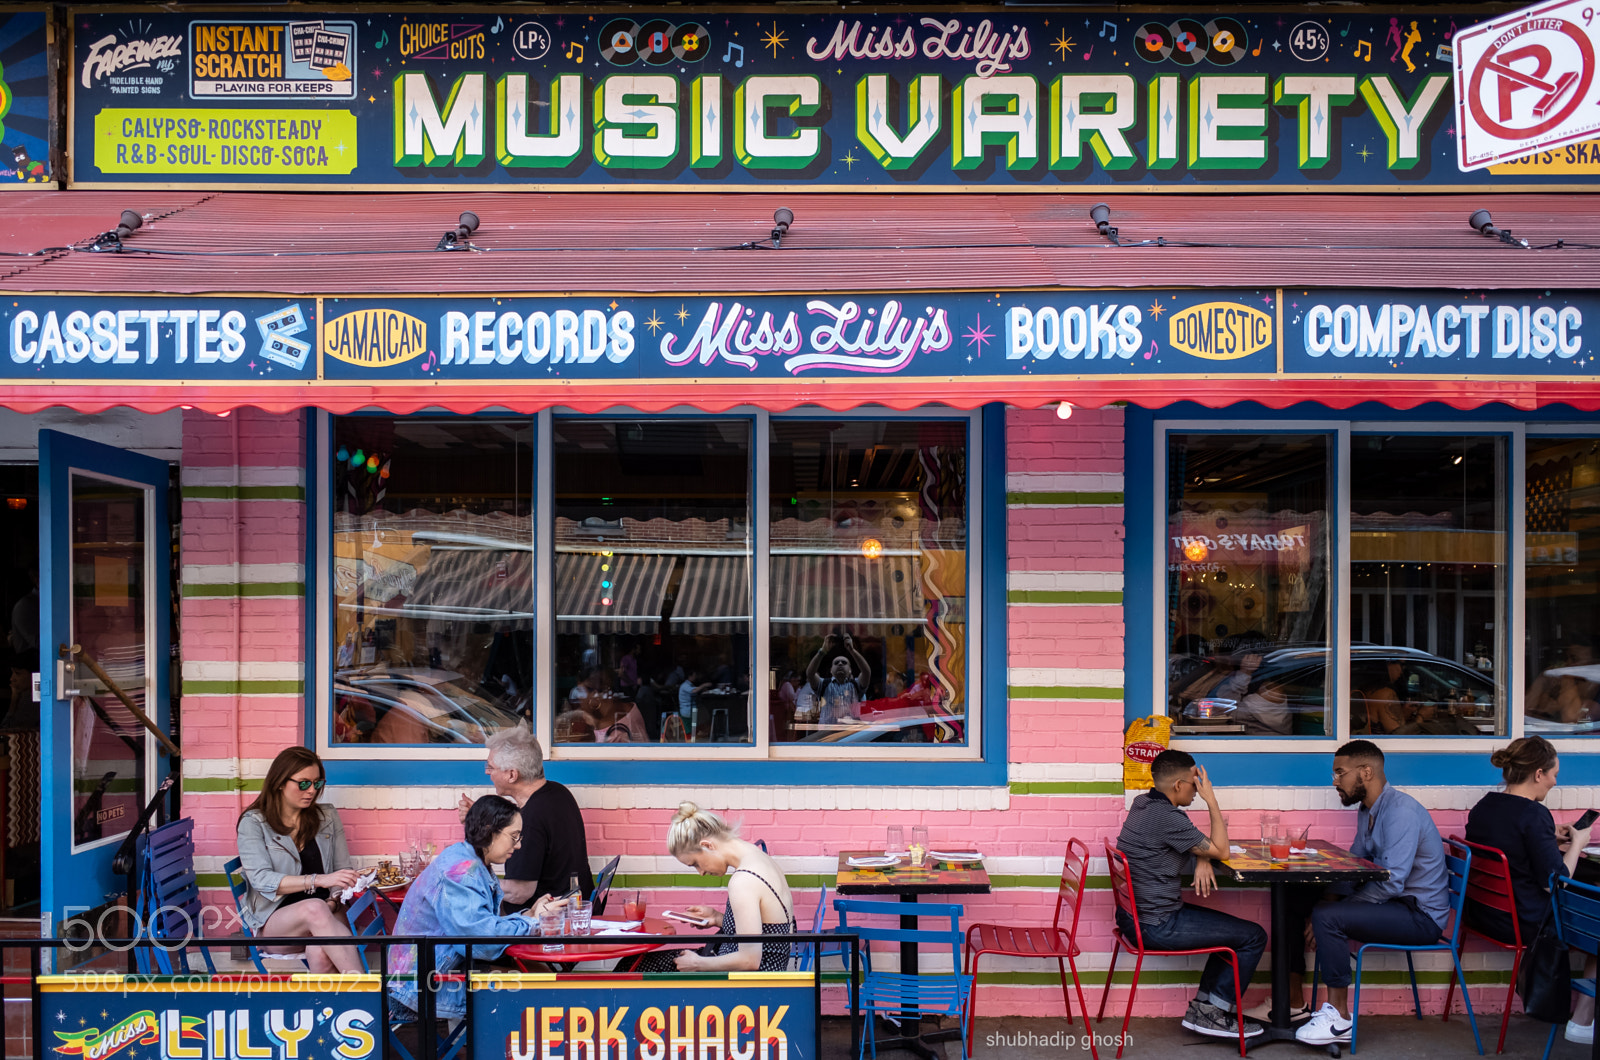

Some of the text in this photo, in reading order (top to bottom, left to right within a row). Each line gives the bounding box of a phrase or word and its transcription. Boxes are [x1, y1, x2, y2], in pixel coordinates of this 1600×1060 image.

[195, 26, 284, 52] INSTANT
[400, 23, 449, 56] CHOICE
[451, 32, 485, 60] CUTS
[519, 30, 546, 50] LP's
[806, 18, 1032, 78] Miss Lily's
[1294, 29, 1326, 51] 45's
[1493, 18, 1563, 50] DON'T LITTER
[81, 34, 184, 89] FAREWELL
[110, 77, 164, 85] INDELIBLE HAND
[195, 54, 283, 78] SCRATCH
[110, 86, 161, 95] PAINTED SIGNS
[214, 82, 334, 94] PLAYING FOR KEEPS
[393, 71, 822, 170] MUSIC
[855, 73, 1452, 170] VARIETY
[10, 309, 247, 364] CASSETTES
[329, 311, 422, 361] JAMAICAN
[440, 309, 635, 365] RECORDS
[660, 300, 953, 375] Miss Lily's
[1004, 304, 1143, 360] BOOKS
[1176, 307, 1267, 355] DOMESTIC
[1303, 303, 1582, 359] COMPACT DISC
[1128, 747, 1164, 758] STRAN
[98, 807, 125, 821] NO PETS
[89, 1015, 148, 1060] Miss
[159, 1006, 376, 1060] LILY'S
[505, 1004, 790, 1060] JERK SHACK
